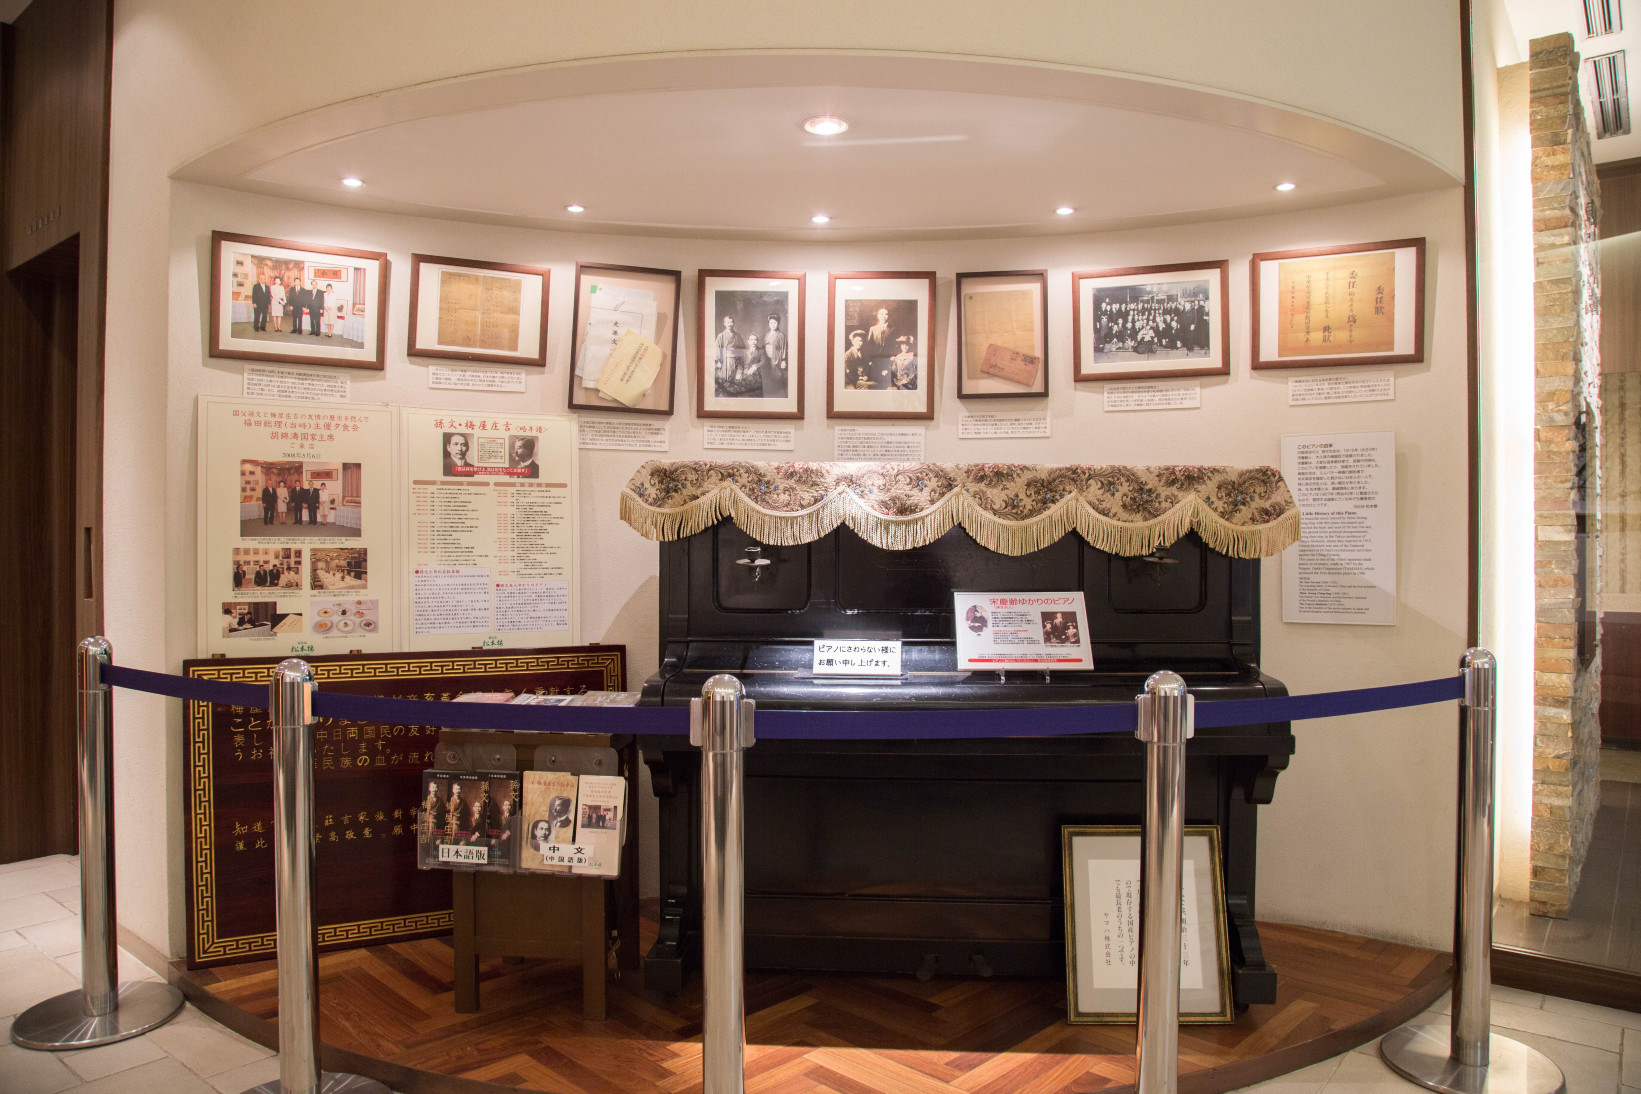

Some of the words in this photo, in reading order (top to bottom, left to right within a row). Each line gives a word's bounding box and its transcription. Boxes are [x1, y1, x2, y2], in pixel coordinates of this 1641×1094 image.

[818, 644, 897, 654] ピアノにさわらない様に
[818, 658, 891, 667] お願い申し上げます。
[441, 848, 486, 860] 日本語版
[1103, 912, 1112, 966] ヤマハ株式会社
